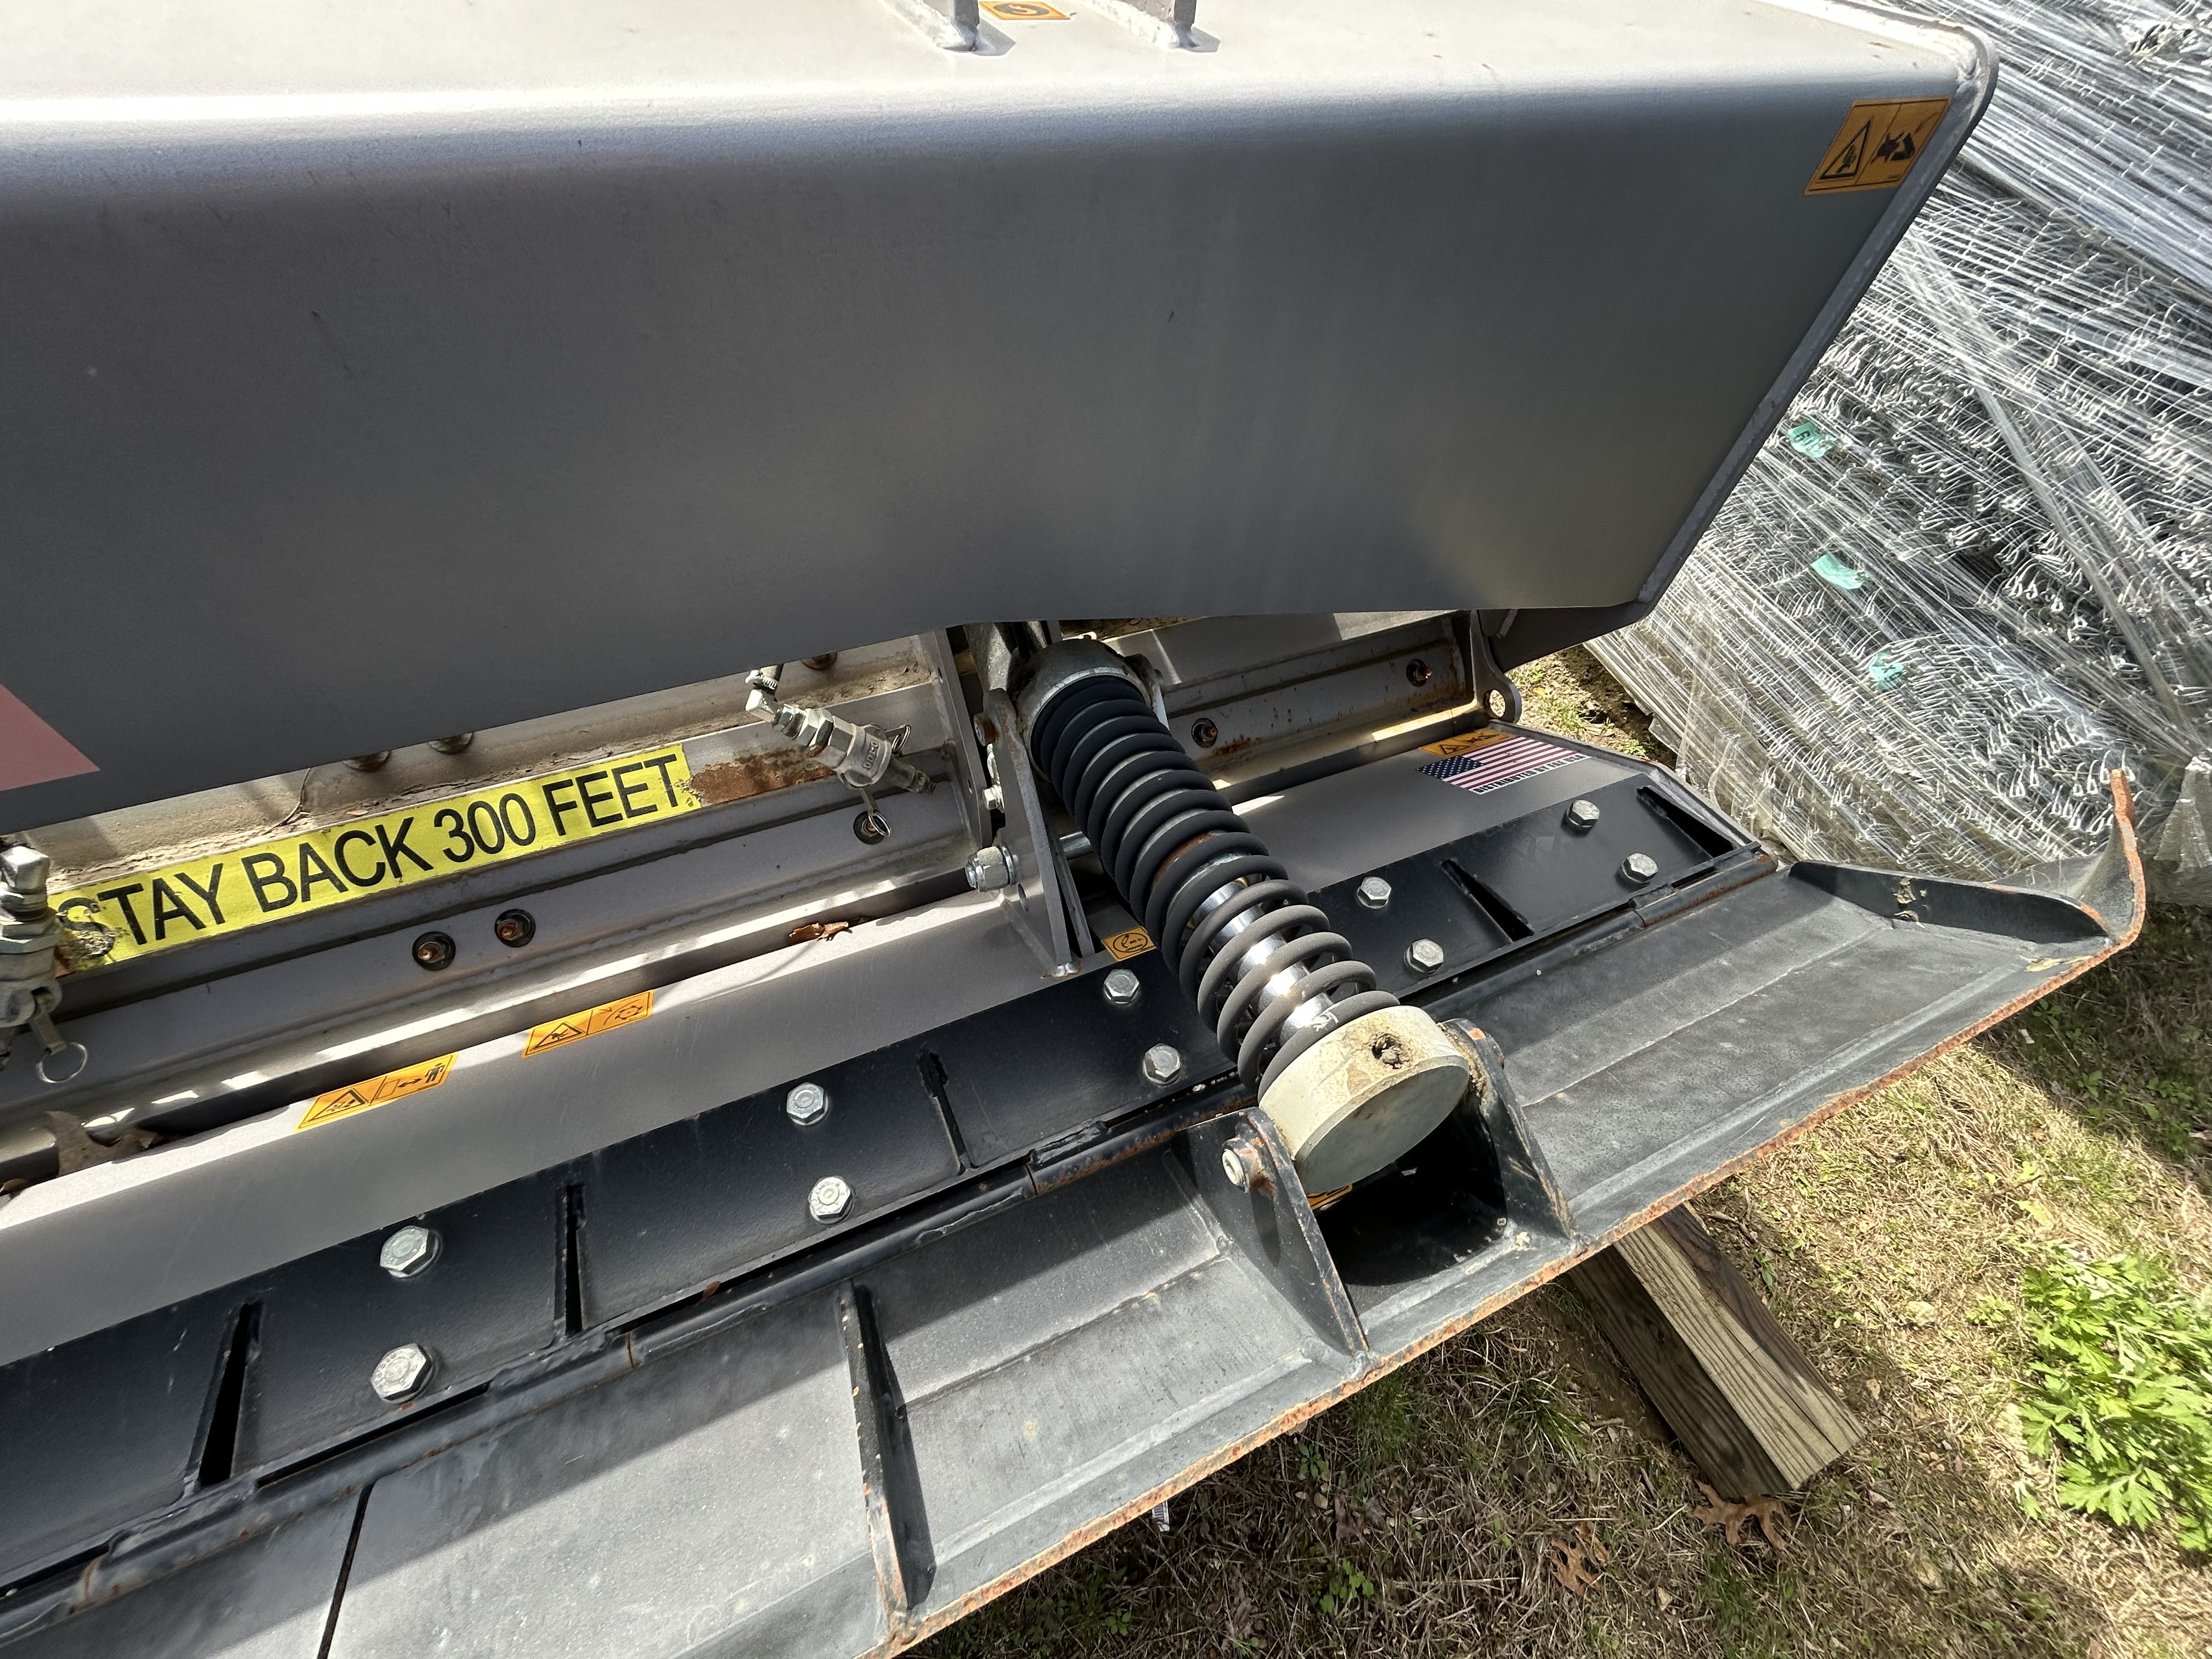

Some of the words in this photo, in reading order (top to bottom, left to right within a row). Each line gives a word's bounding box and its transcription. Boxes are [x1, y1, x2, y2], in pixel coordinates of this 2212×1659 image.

[1472, 770, 1537, 793] DISTRIBUTED
[1535, 765, 1550, 774] BY
[1548, 760, 1565, 768] FAE
[1564, 754, 1587, 763] USA
[57, 863, 225, 957] STAY
[241, 816, 435, 912] BACK
[433, 792, 536, 863] 300
[543, 754, 680, 837] FEET
